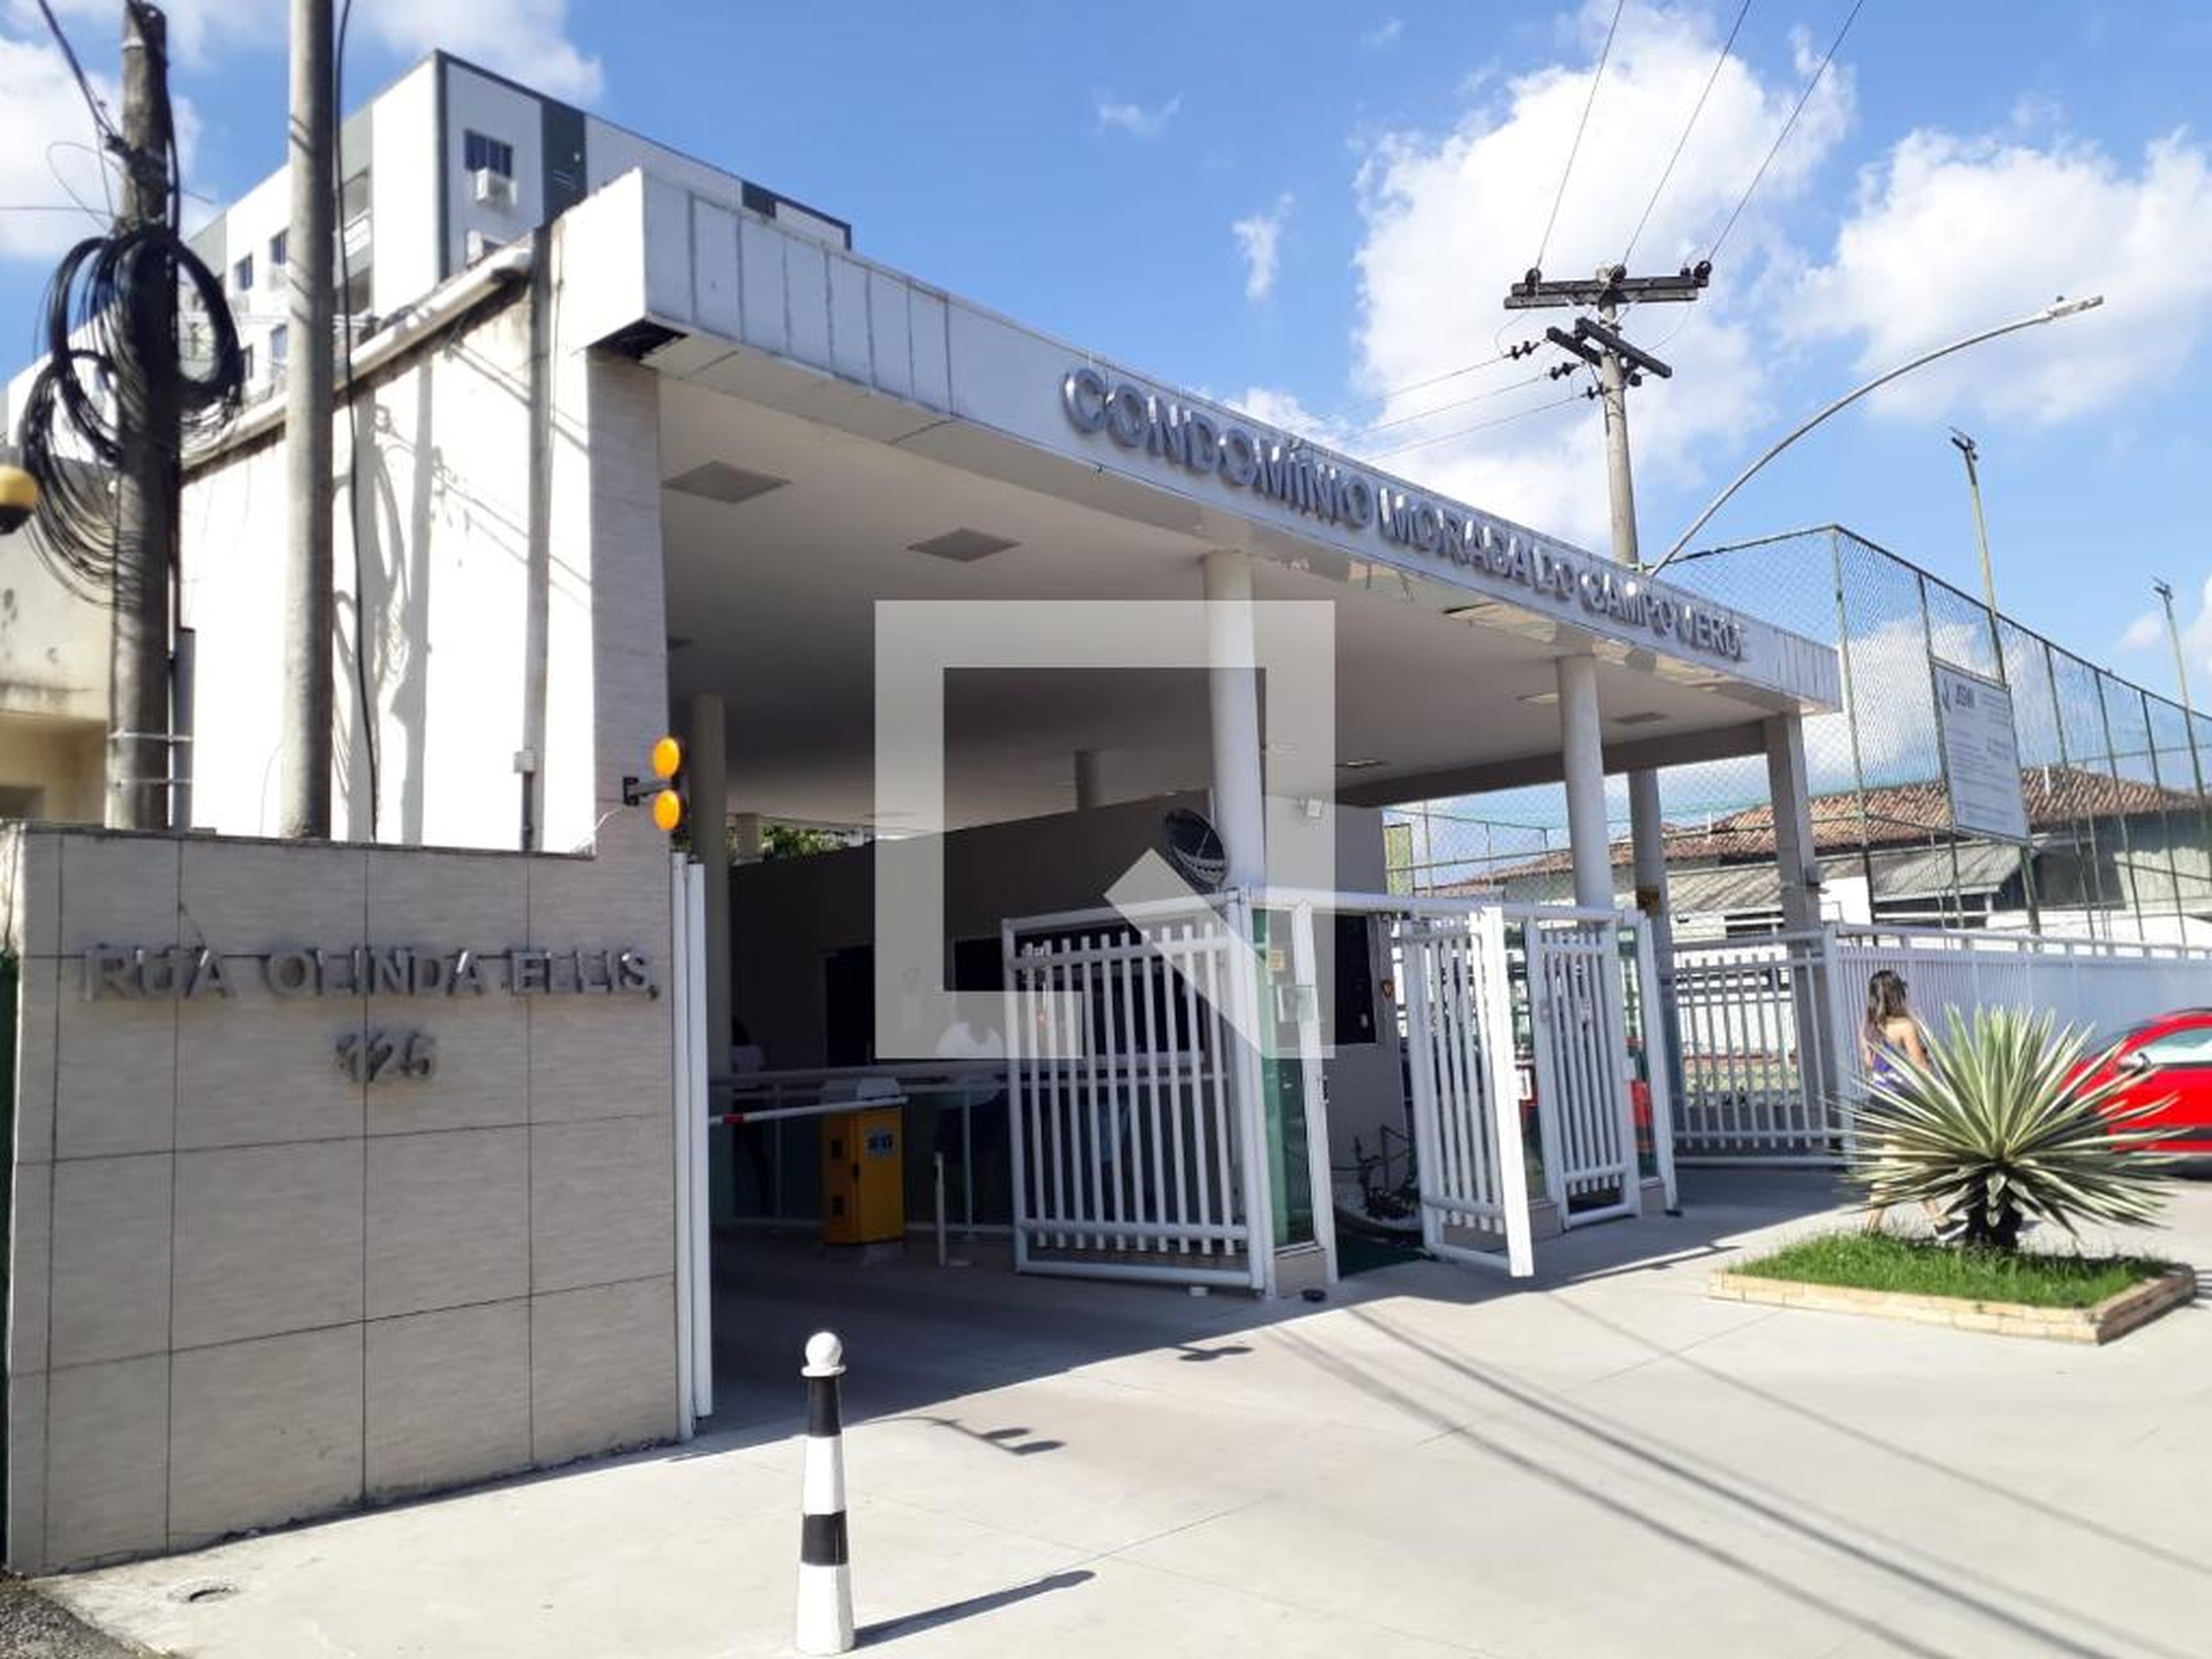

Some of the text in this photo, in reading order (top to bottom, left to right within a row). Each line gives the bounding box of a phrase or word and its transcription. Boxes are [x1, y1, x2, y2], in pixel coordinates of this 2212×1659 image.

[1378, 487, 1531, 588] MORADA
[1531, 544, 1578, 601] DO
[1578, 570, 1678, 635] CAMPO
[84, 946, 236, 1001] RUA
[263, 946, 487, 998] OLINDA
